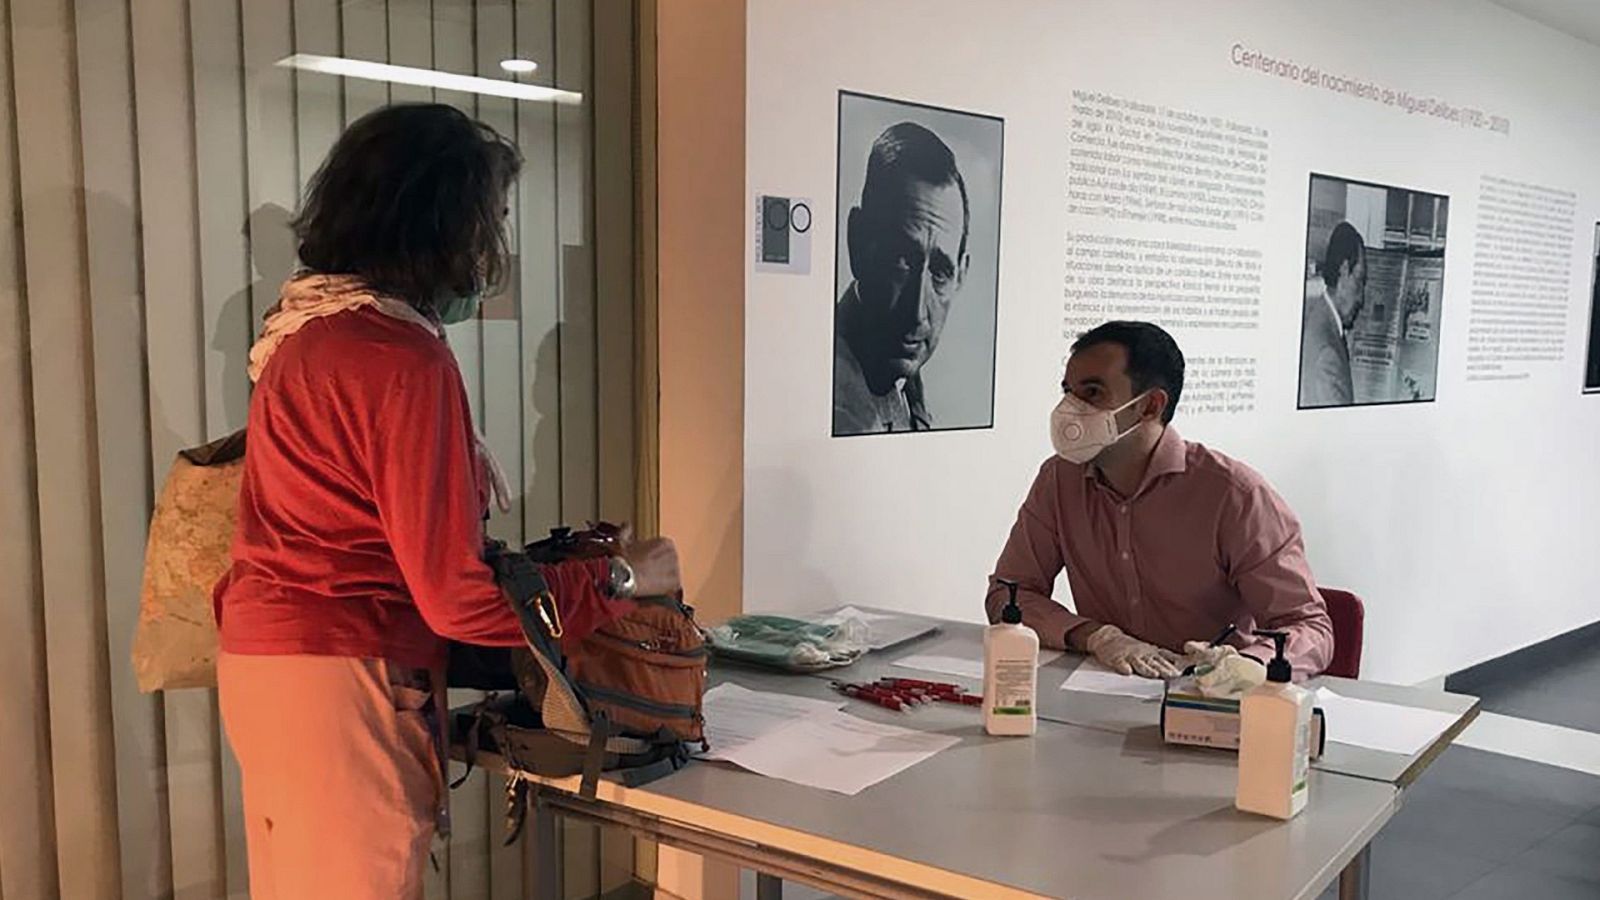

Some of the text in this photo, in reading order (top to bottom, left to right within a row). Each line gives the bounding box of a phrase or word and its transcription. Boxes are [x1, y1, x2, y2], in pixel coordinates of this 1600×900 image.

[1231, 44, 1300, 80] Centenario
[1301, 67, 1320, 88] del
[1321, 74, 1380, 102] nacimiento
[1382, 89, 1396, 106] de
[1397, 91, 1427, 114] Miguel
